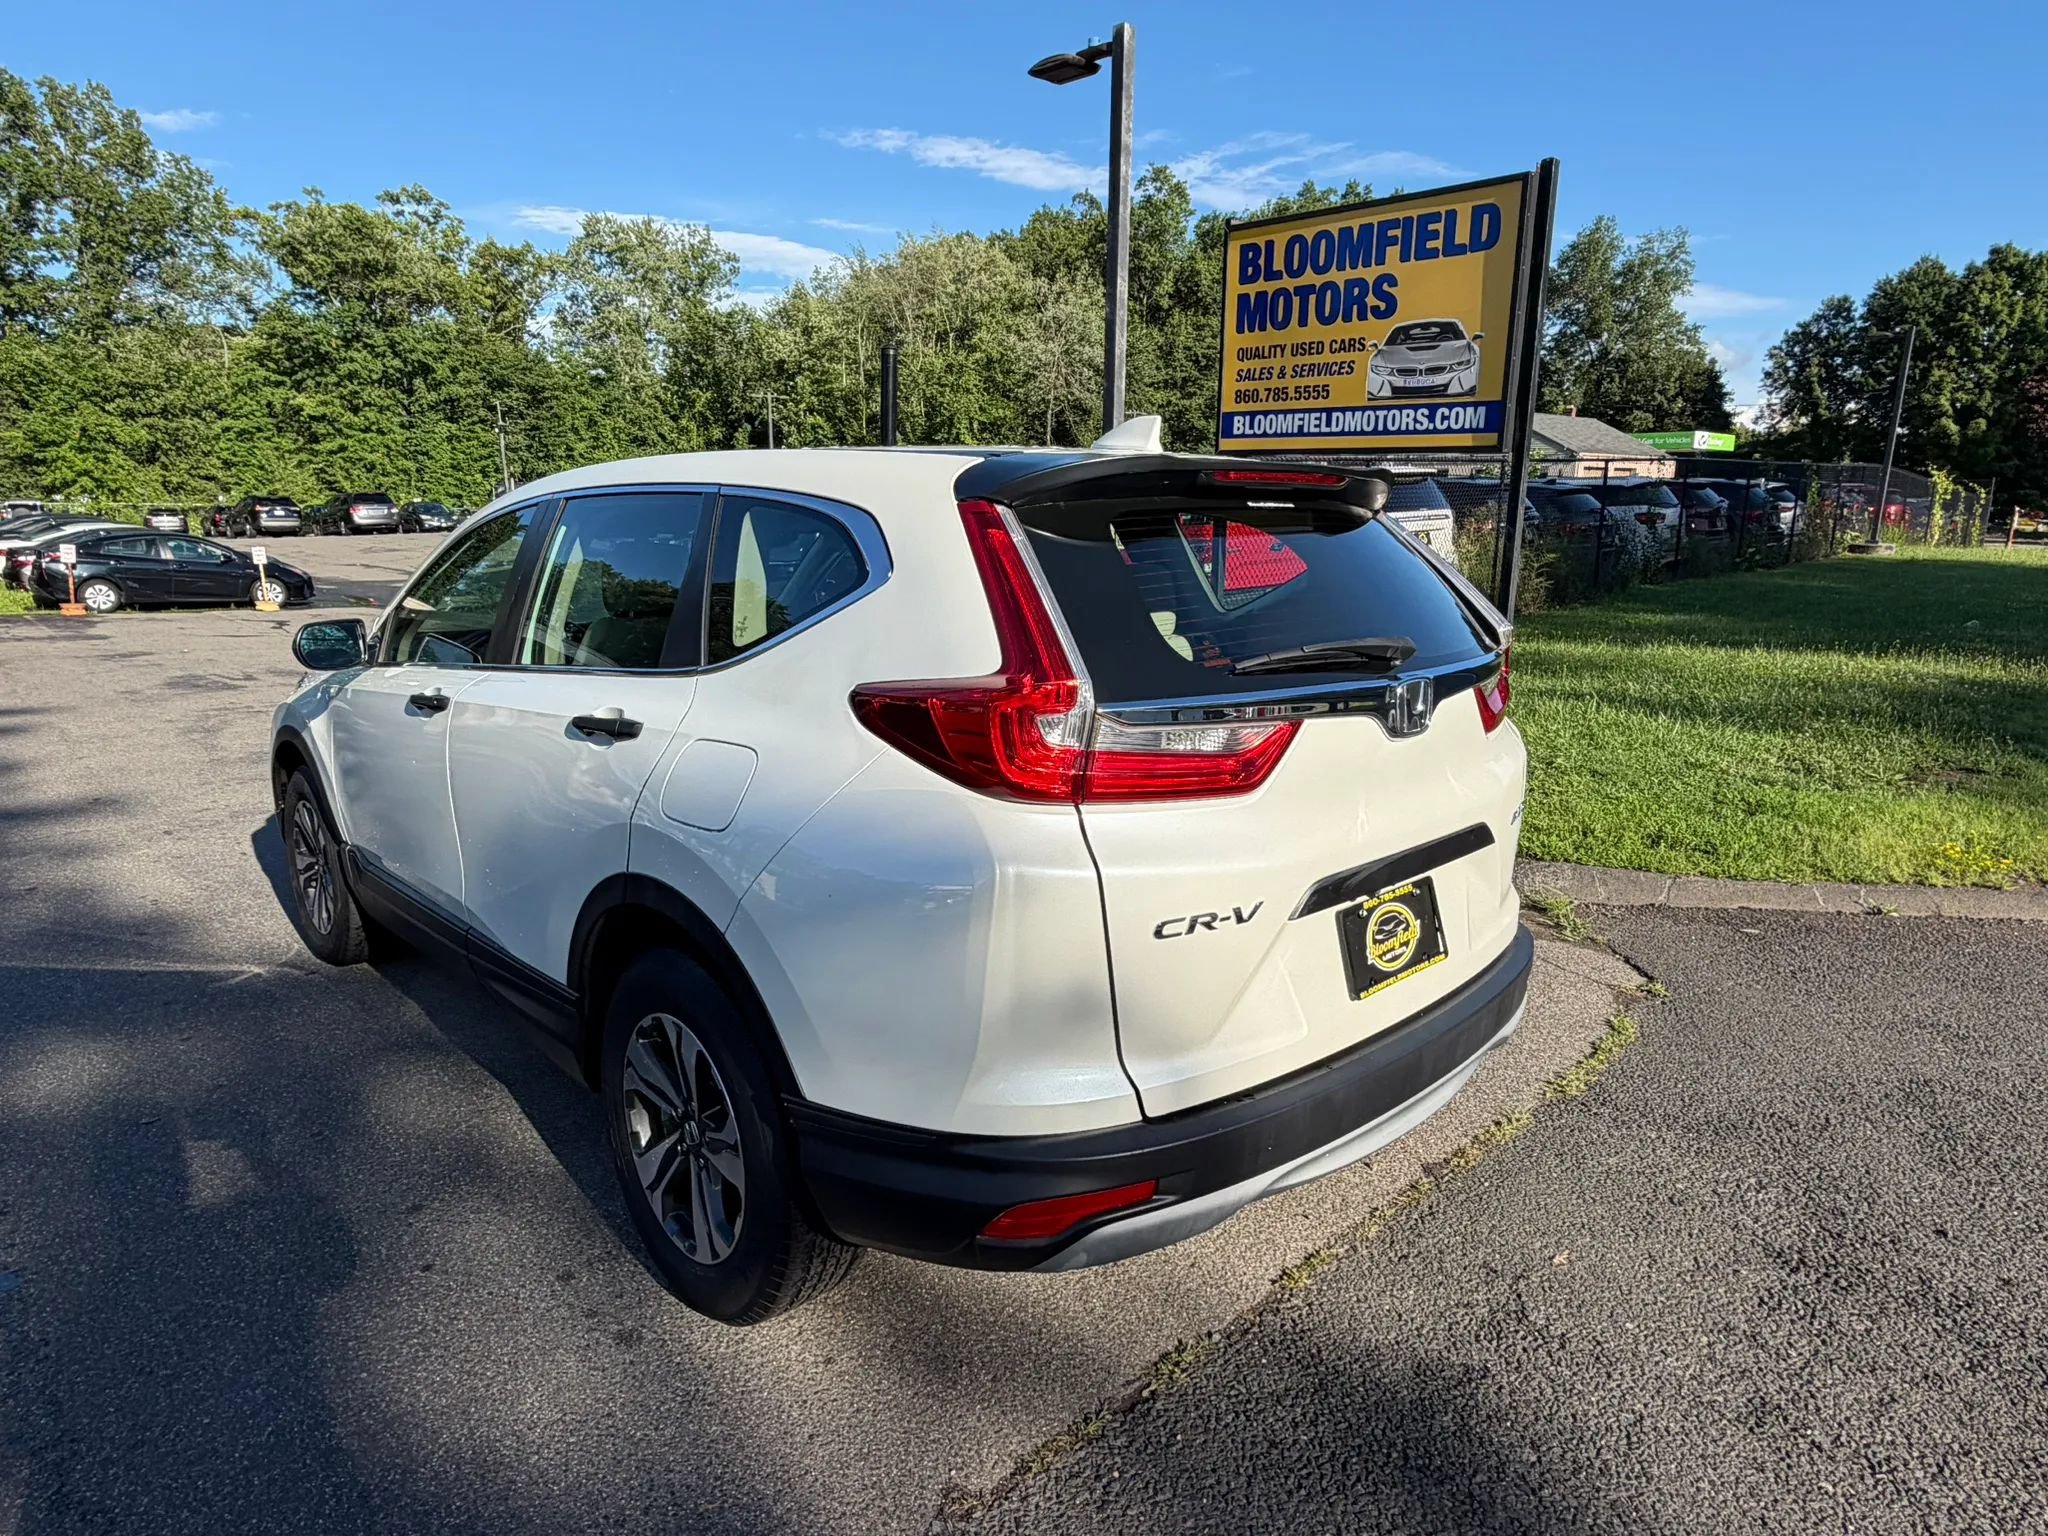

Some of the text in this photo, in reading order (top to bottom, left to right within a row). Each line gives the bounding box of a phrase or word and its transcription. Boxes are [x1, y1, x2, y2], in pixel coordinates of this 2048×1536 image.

[1238, 202, 1502, 286] BLOOMFIELD
[1235, 273, 1399, 334] MOTORS
[1237, 337, 1366, 362] QUALITY USED CARS
[1235, 360, 1356, 383] SALES & SERVICES
[1234, 384, 1331, 405] 860.785.5555
[1232, 406, 1487, 435] BLOOMFIELDMOTORS.COM
[1153, 900, 1265, 940] CR-V
